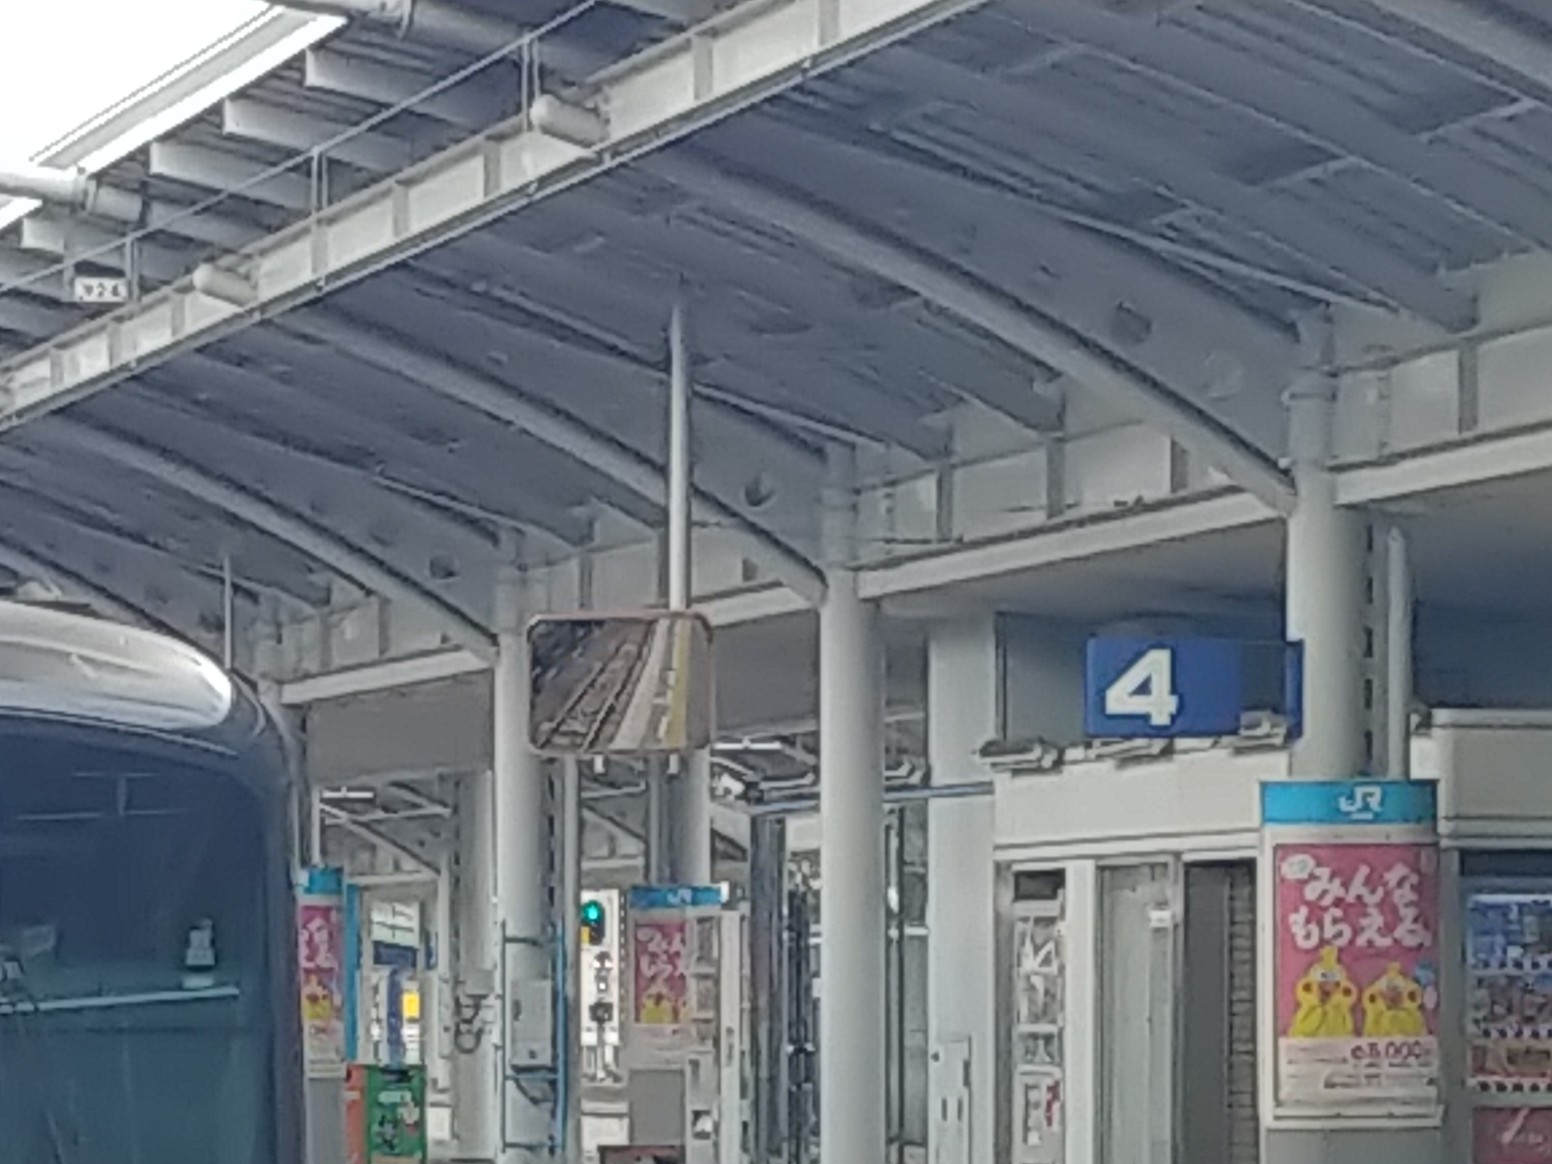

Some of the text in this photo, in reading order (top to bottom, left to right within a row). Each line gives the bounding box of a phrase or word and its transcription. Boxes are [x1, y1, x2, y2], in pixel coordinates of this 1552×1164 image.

[1104, 647, 1180, 726] 4
[1338, 785, 1383, 811] JR
[1303, 862, 1420, 906] みんな
